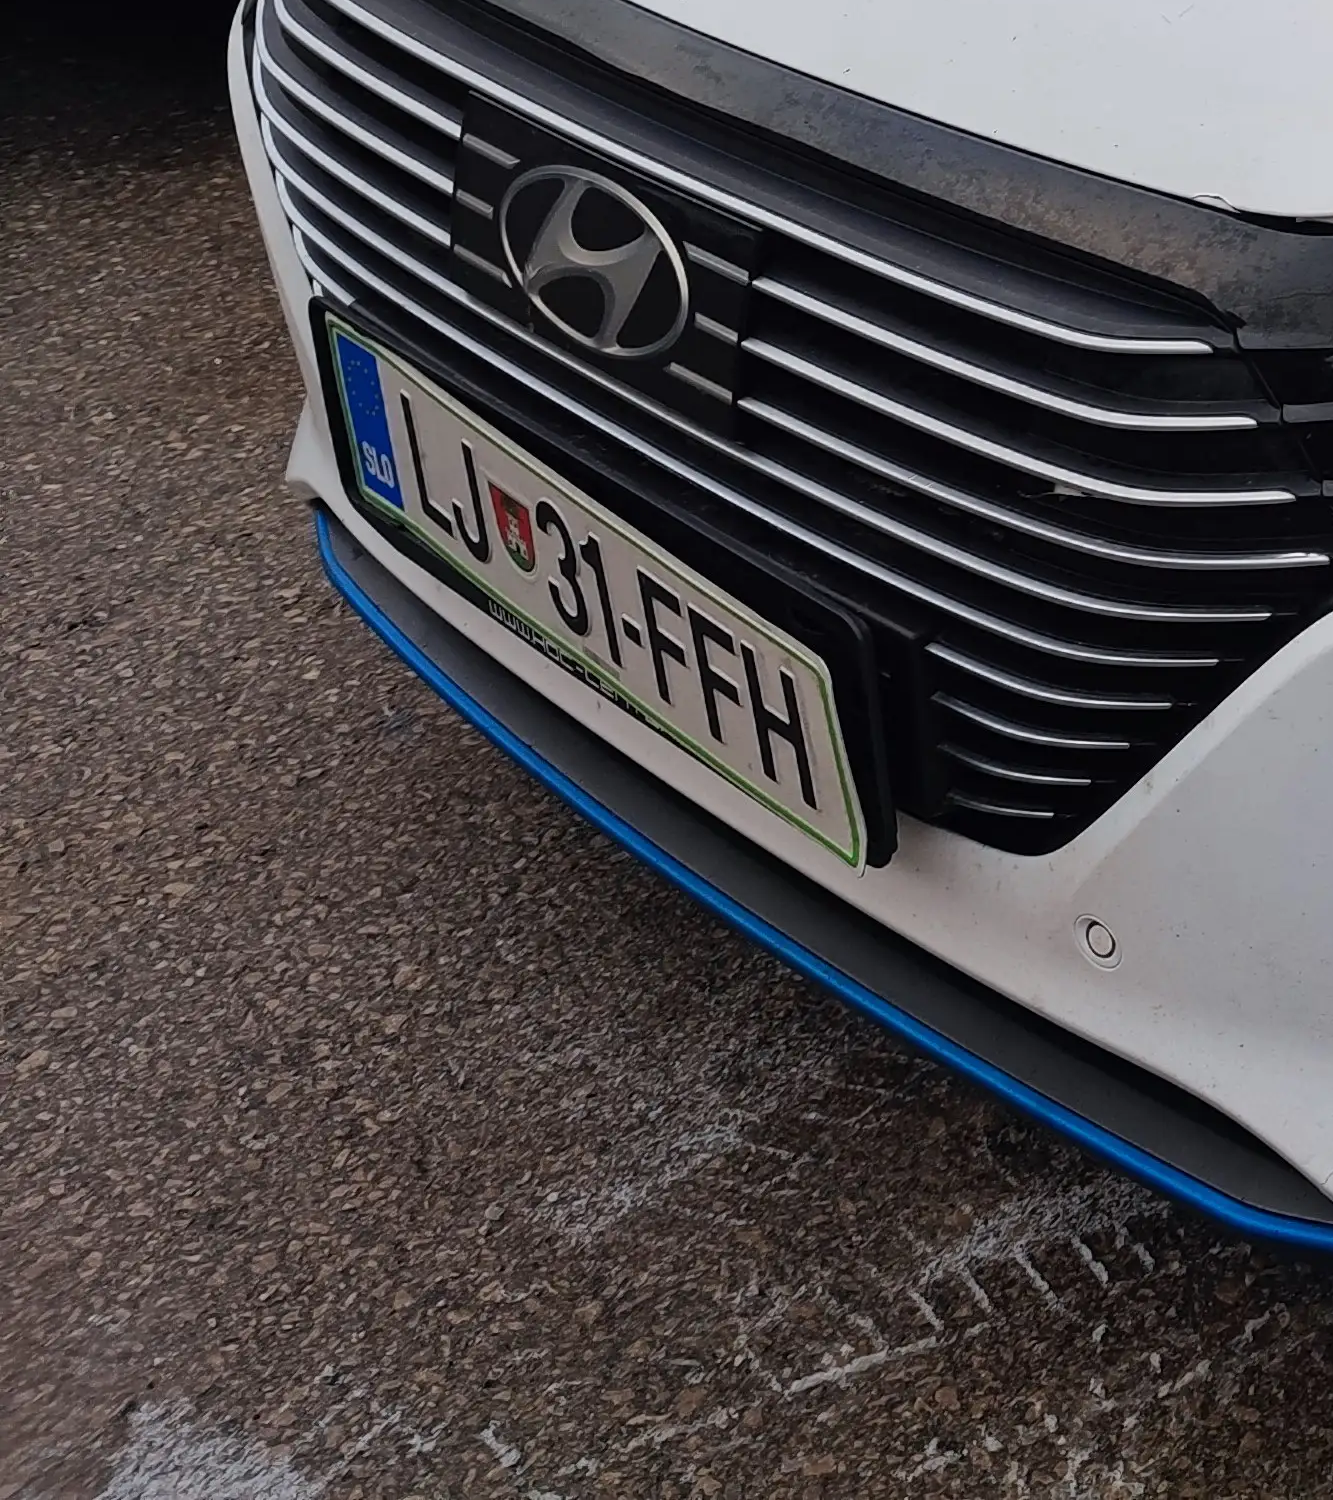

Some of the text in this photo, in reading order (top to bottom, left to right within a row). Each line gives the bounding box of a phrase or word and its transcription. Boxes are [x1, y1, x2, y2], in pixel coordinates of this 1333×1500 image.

[361, 440, 395, 489] SLO
[399, 390, 818, 811] LJ 31-FFH
